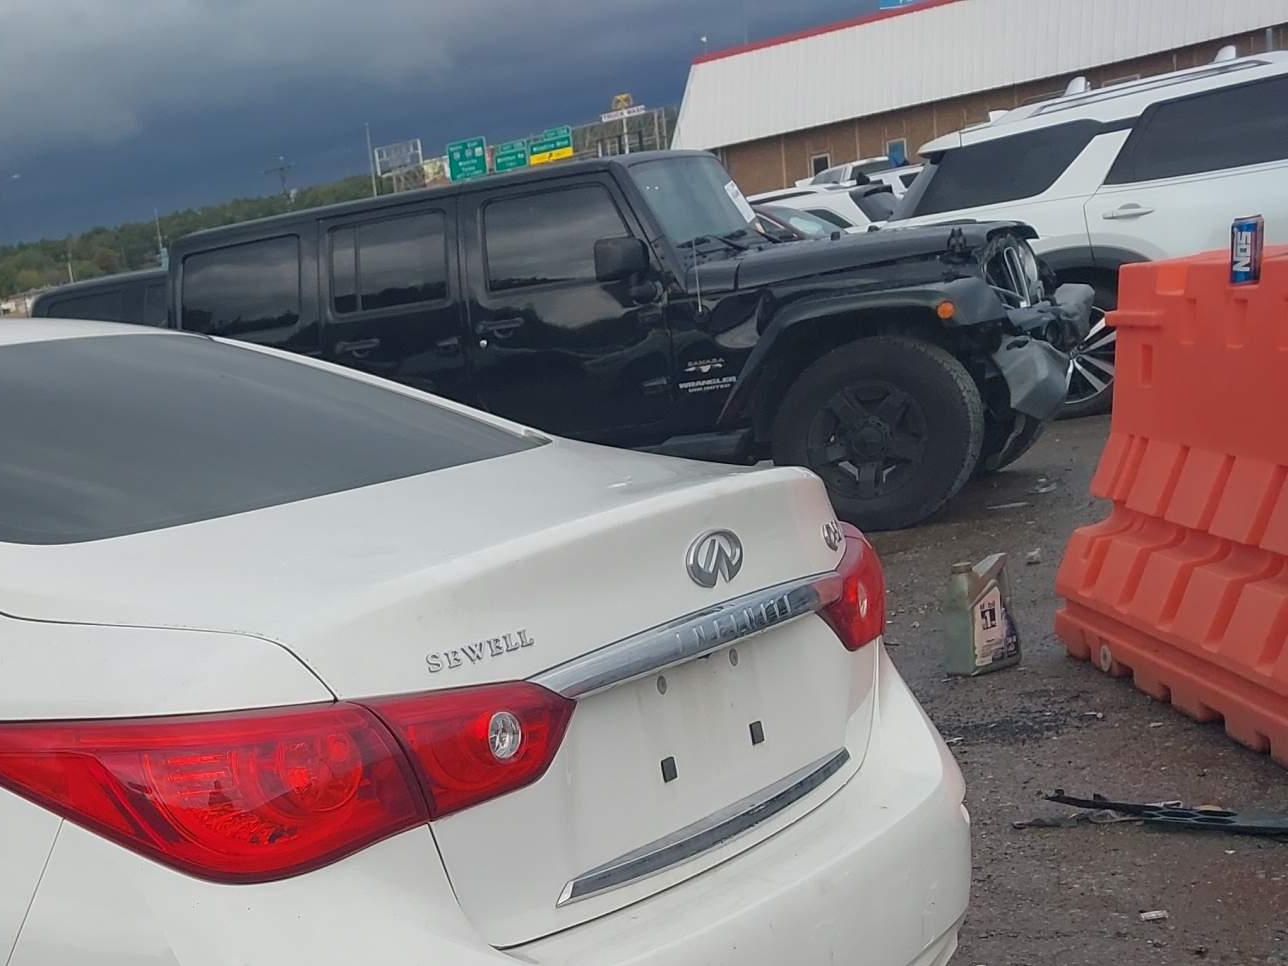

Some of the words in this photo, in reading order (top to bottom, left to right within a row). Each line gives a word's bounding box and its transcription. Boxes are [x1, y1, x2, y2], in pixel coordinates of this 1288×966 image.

[1233, 231, 1252, 272] NOS
[679, 375, 737, 389] WRANGLER
[425, 629, 535, 673] SEWELL
